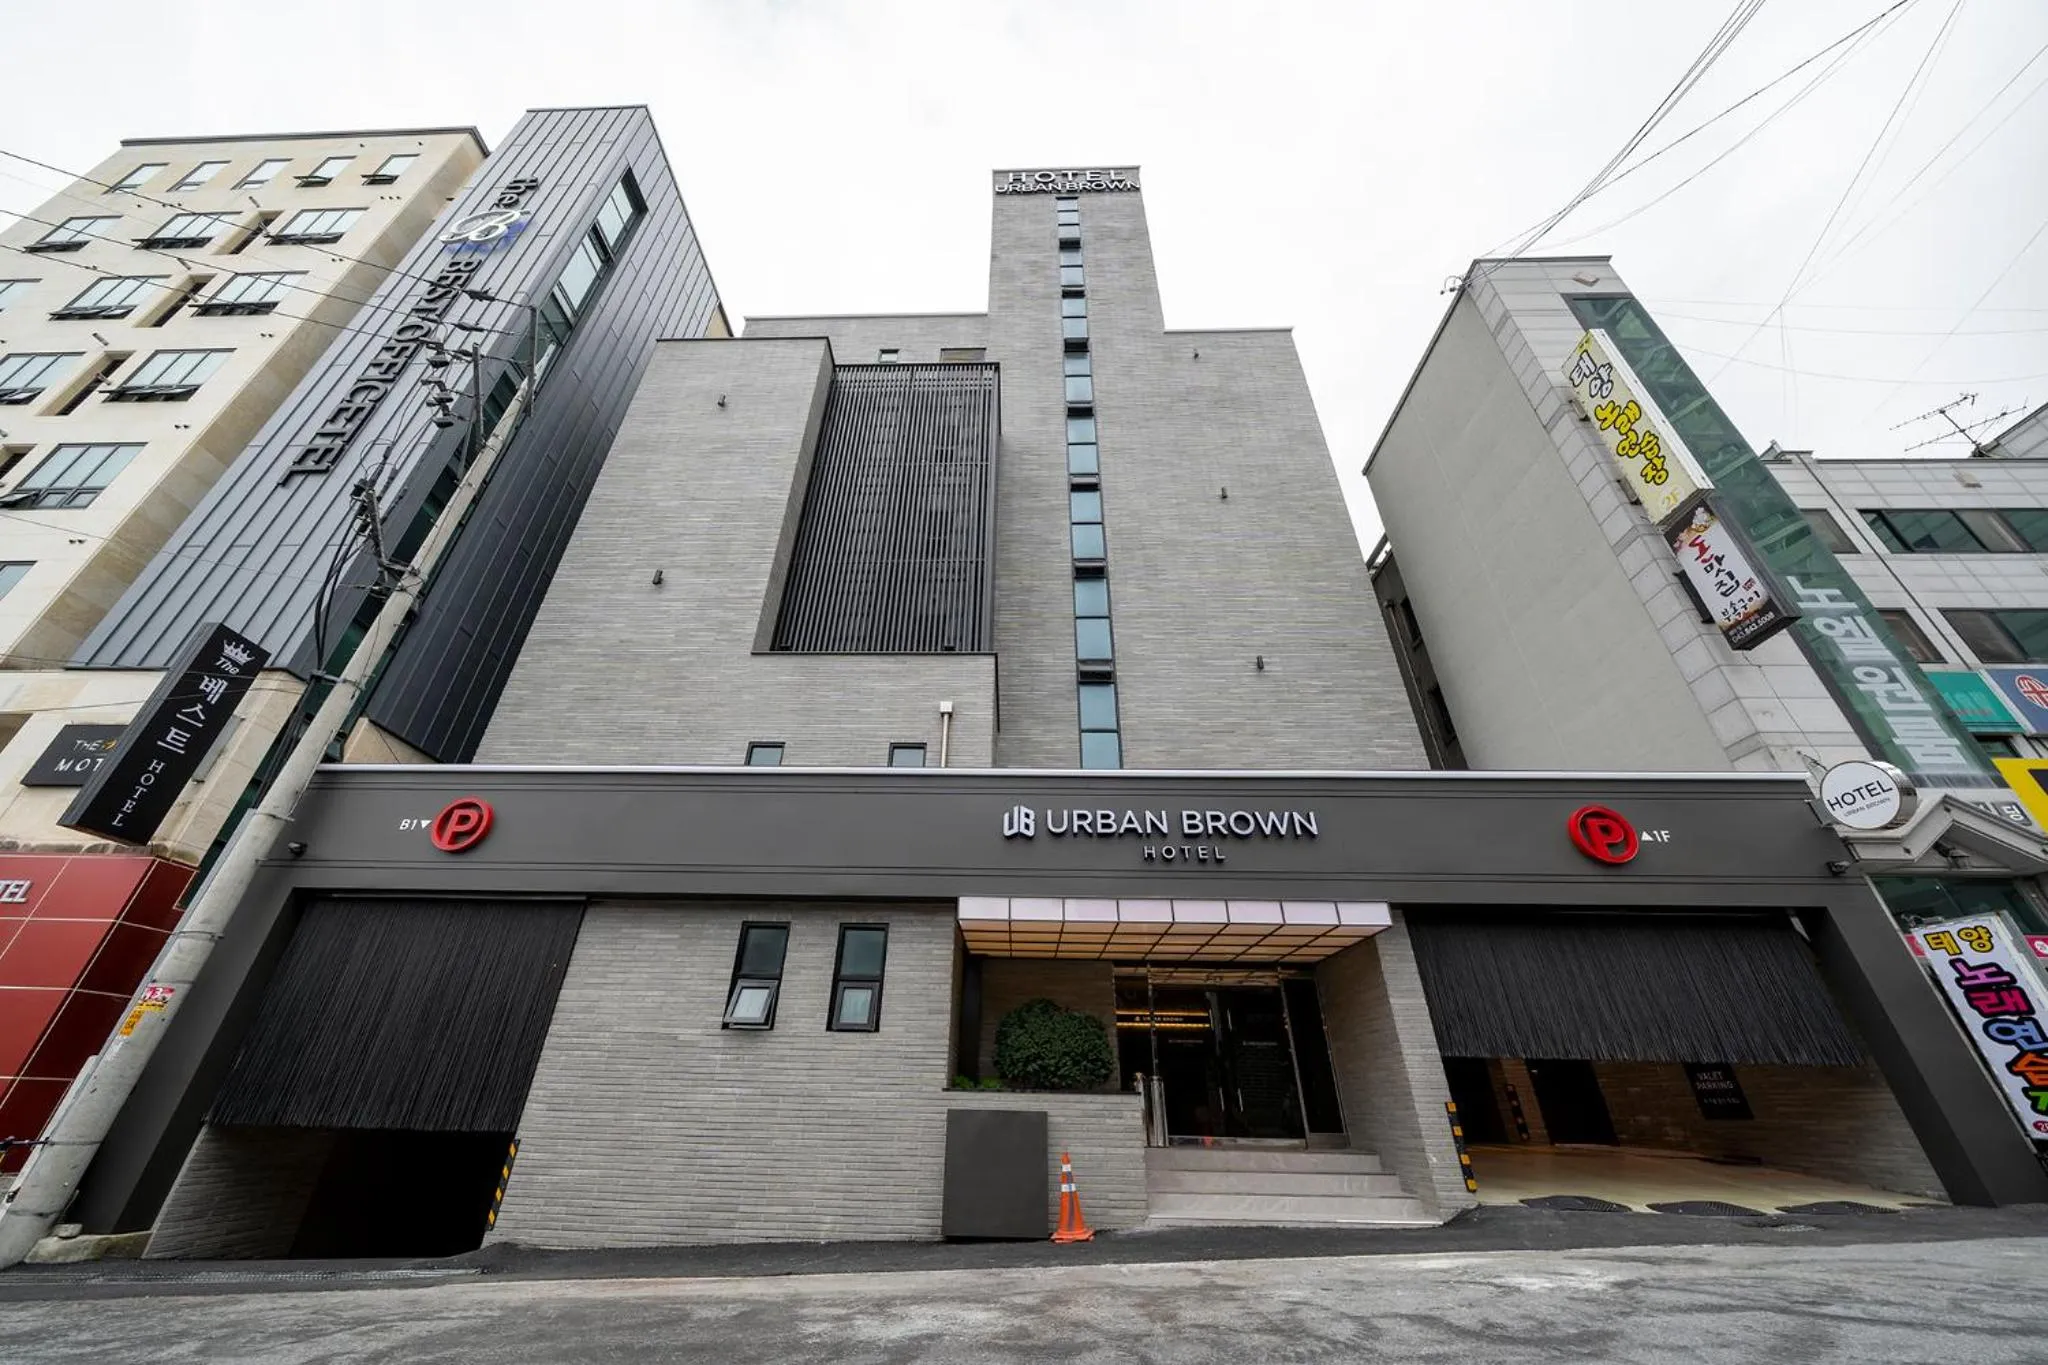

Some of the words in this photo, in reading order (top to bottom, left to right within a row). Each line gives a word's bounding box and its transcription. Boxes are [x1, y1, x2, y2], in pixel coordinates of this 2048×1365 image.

[995, 182, 1062, 192] URBAN
[1065, 181, 1141, 191] BROWN
[1009, 170, 1126, 182] HOTEL
[489, 177, 539, 211] the
[412, 258, 482, 323] BEST
[1569, 350, 1613, 398] 태양
[277, 322, 434, 488] OFFICETEL
[1594, 400, 1668, 485] 노래연습장
[1689, 535, 1740, 597] 돈맛집
[213, 656, 240, 675] The
[156, 675, 229, 755] 베스트
[112, 759, 166, 827] HOTEL
[1827, 780, 1893, 811] HOTEL
[399, 819, 418, 831] B1
[1047, 809, 1169, 836] URBAN
[1181, 810, 1320, 838] BROWN
[1653, 830, 1671, 842] 1F
[1144, 845, 1226, 860] HOTEL
[1924, 925, 1994, 955] 태양
